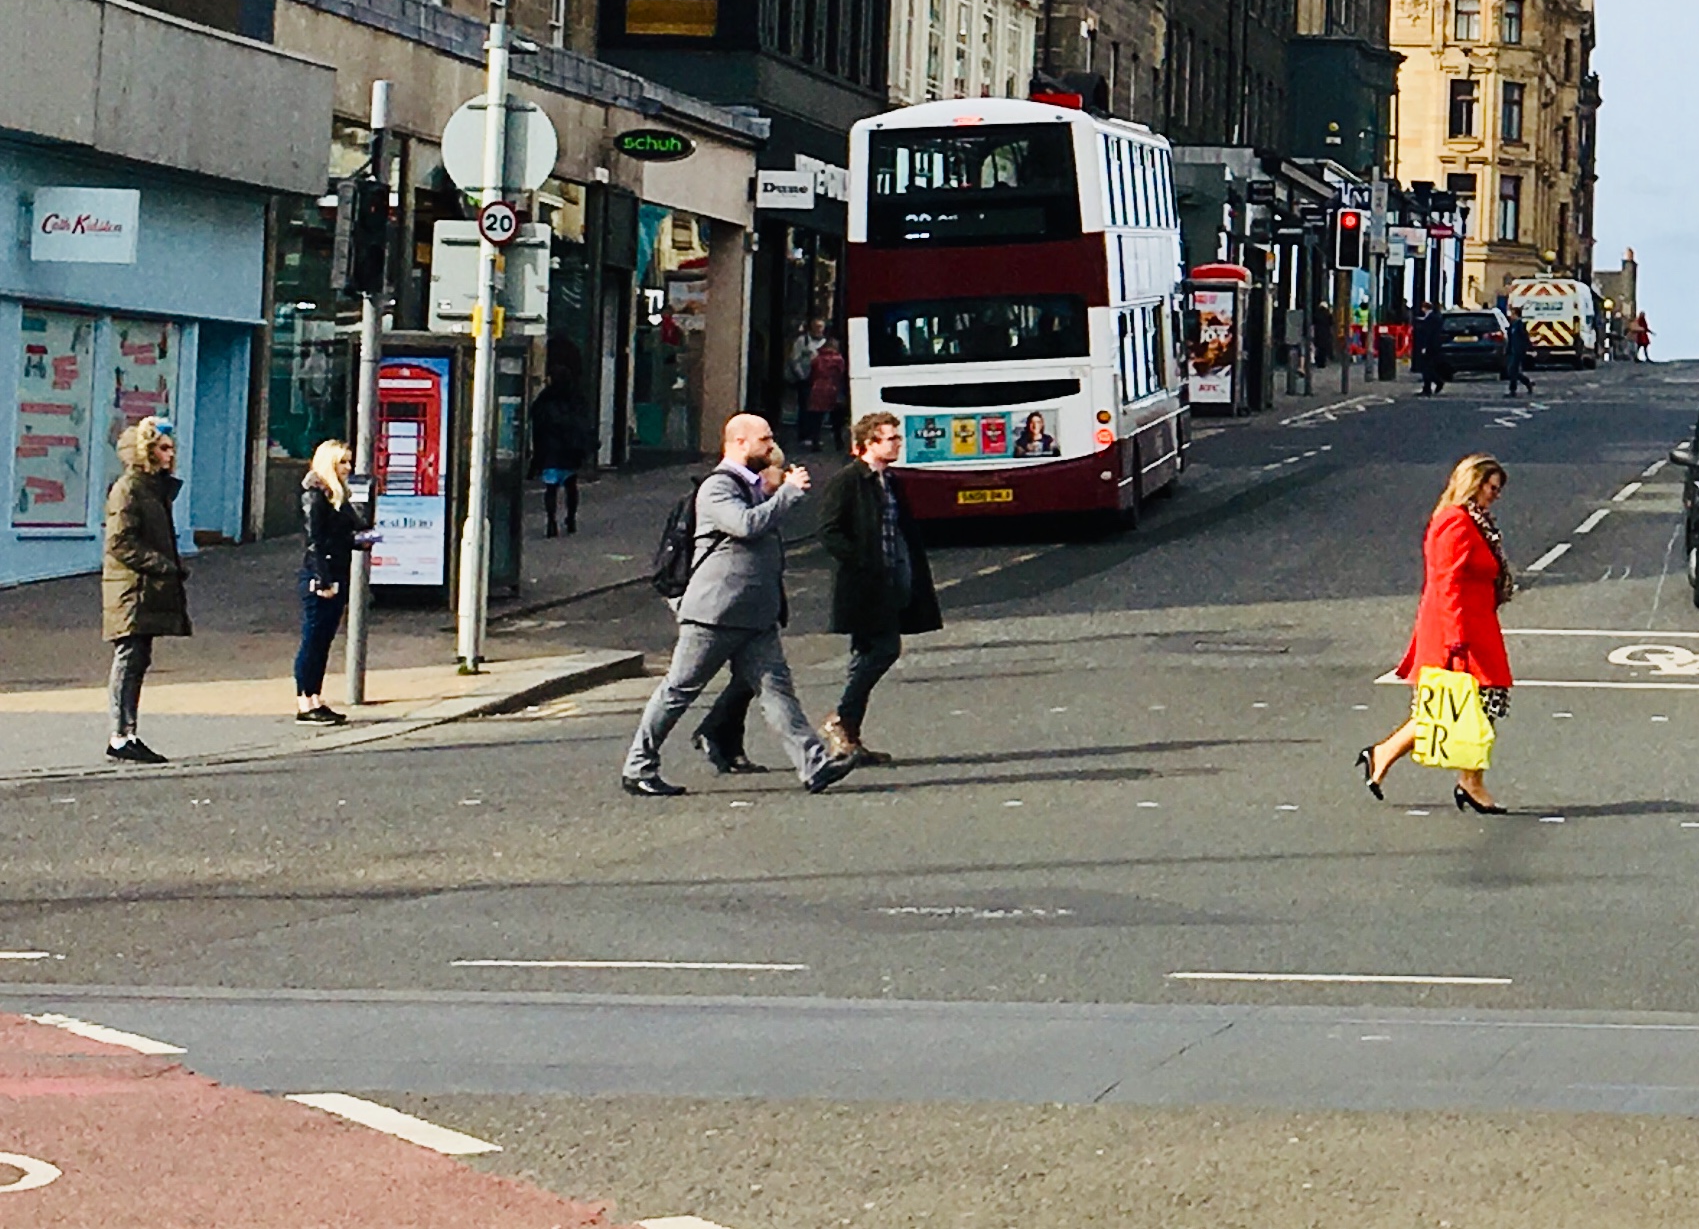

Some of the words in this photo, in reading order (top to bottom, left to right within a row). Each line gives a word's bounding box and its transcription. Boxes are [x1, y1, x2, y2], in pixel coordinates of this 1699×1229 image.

[623, 134, 682, 151] schuh
[762, 182, 809, 194] Dune
[42, 213, 70, 234] Cath
[485, 213, 513, 232] 20
[1416, 685, 1472, 722] RIV
